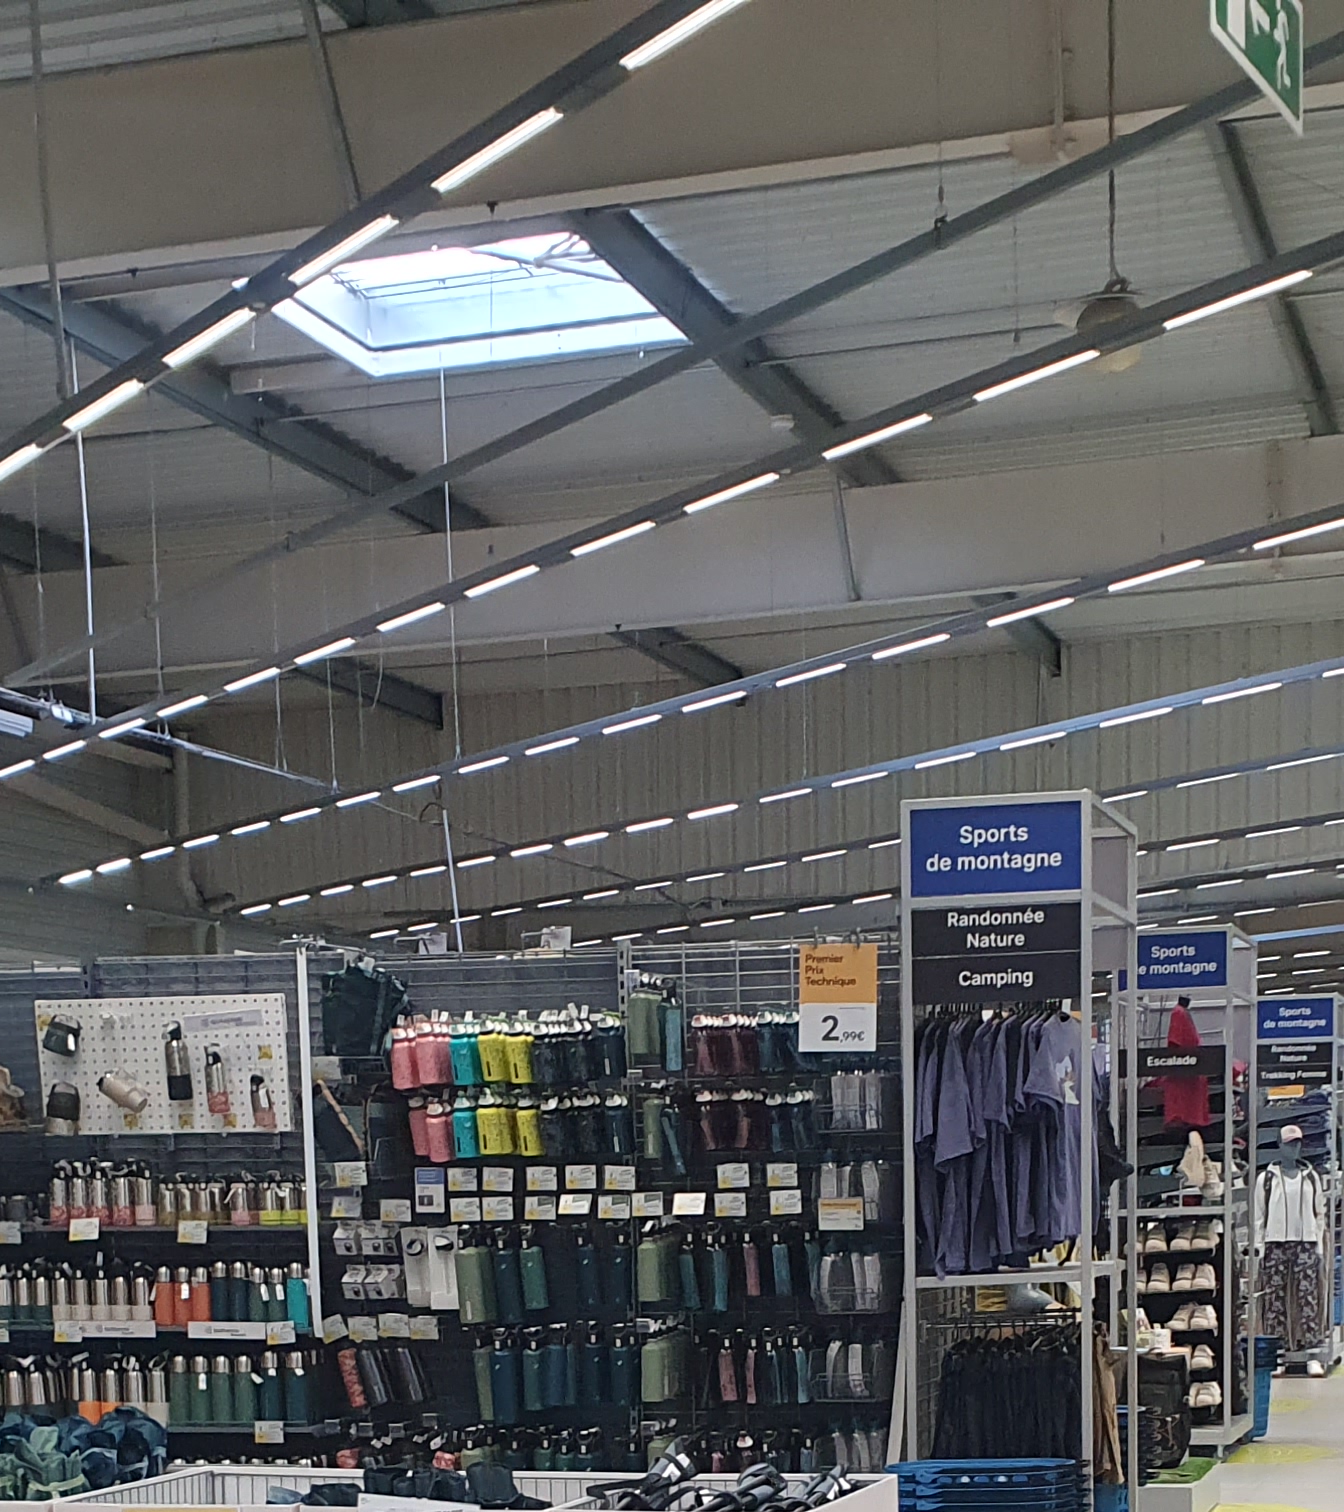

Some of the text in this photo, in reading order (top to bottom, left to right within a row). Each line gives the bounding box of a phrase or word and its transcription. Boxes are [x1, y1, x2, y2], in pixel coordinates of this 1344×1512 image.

[959, 825, 1029, 847] Sports
[926, 851, 1062, 872] de montagne
[947, 908, 1045, 928] Randonnée
[966, 933, 1025, 949] Nature
[805, 953, 843, 963] Premier
[1151, 945, 1196, 960] Sports
[805, 965, 824, 975] Prix
[1138, 961, 1218, 975] e montagne
[805, 977, 856, 987] Technique
[958, 969, 1034, 989] Camping
[1279, 1007, 1312, 1018] Sports
[821, 1015, 865, 1043] 2,99€
[1147, 1055, 1197, 1067] Escalade
